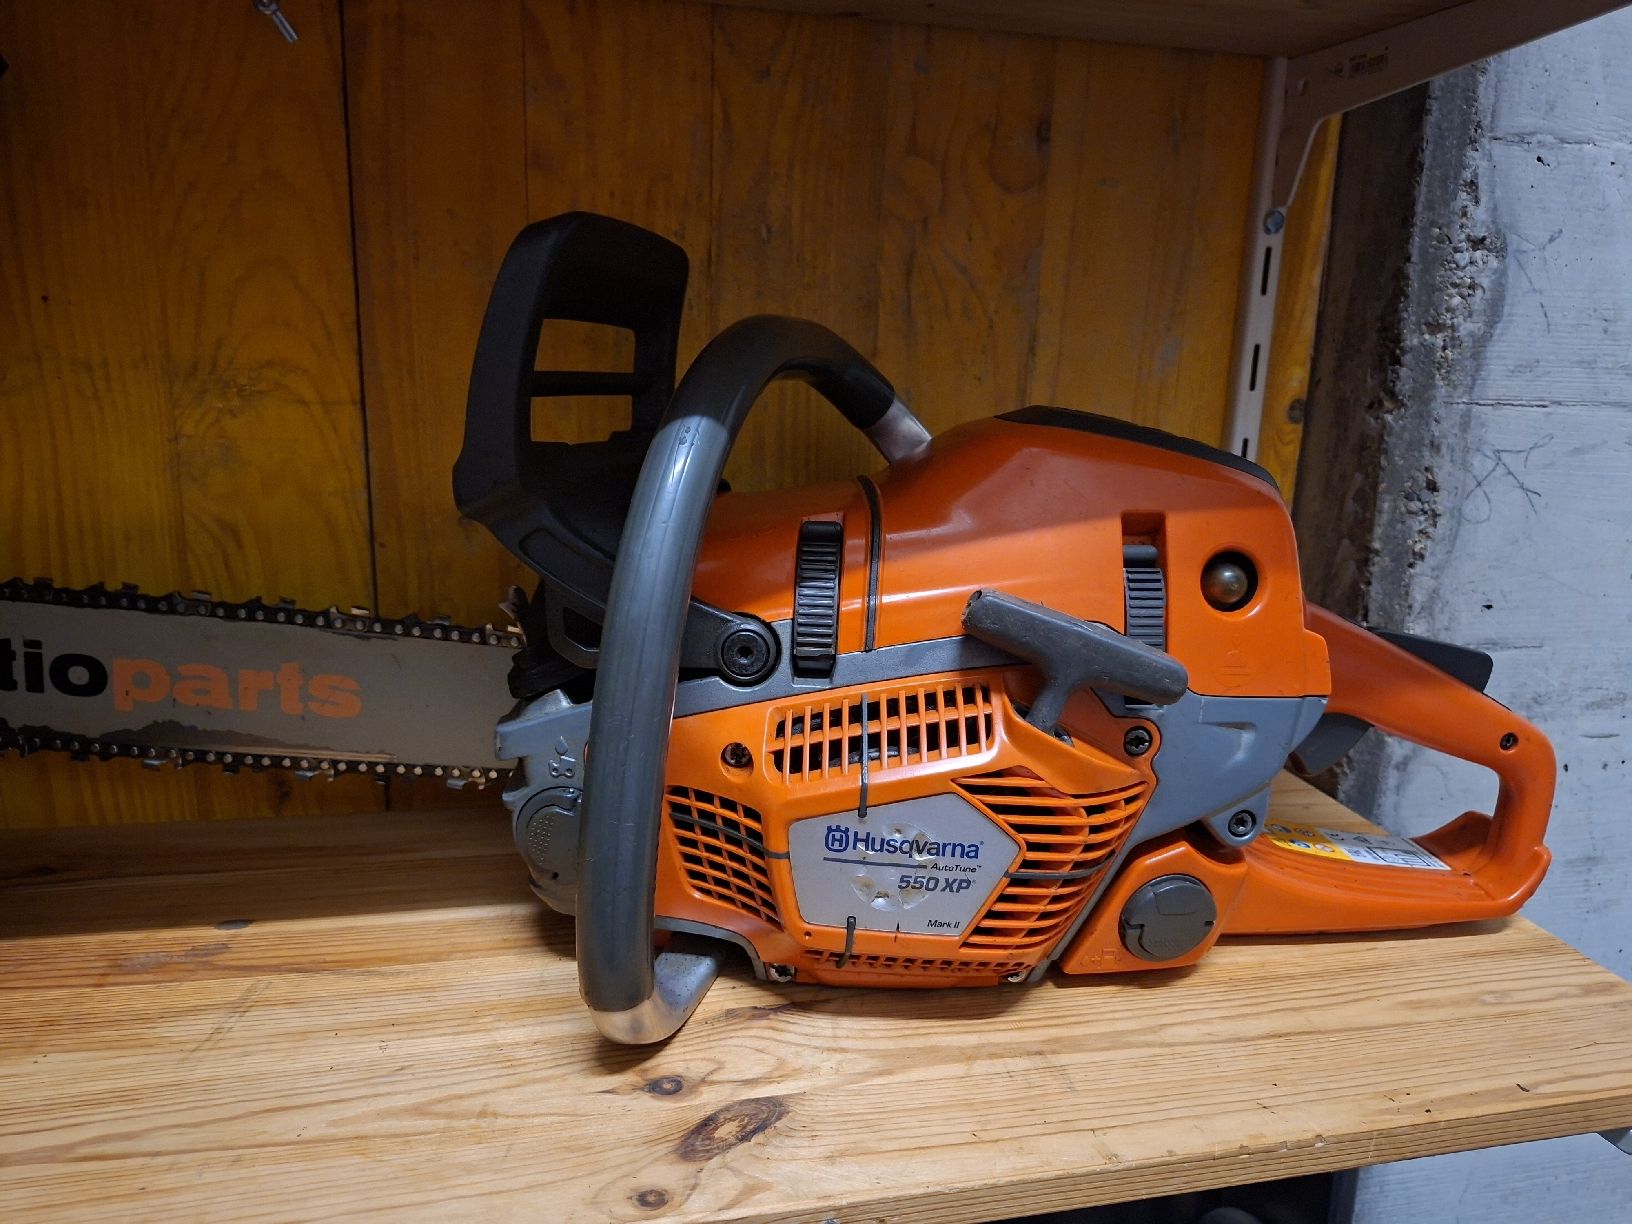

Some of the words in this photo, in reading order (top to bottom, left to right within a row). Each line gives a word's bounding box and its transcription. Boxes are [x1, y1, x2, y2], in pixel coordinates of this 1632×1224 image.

[852, 831, 979, 859] Husqvarna
[897, 874, 940, 892] 550
[927, 919, 951, 929] Mark
[953, 921, 960, 929] II
